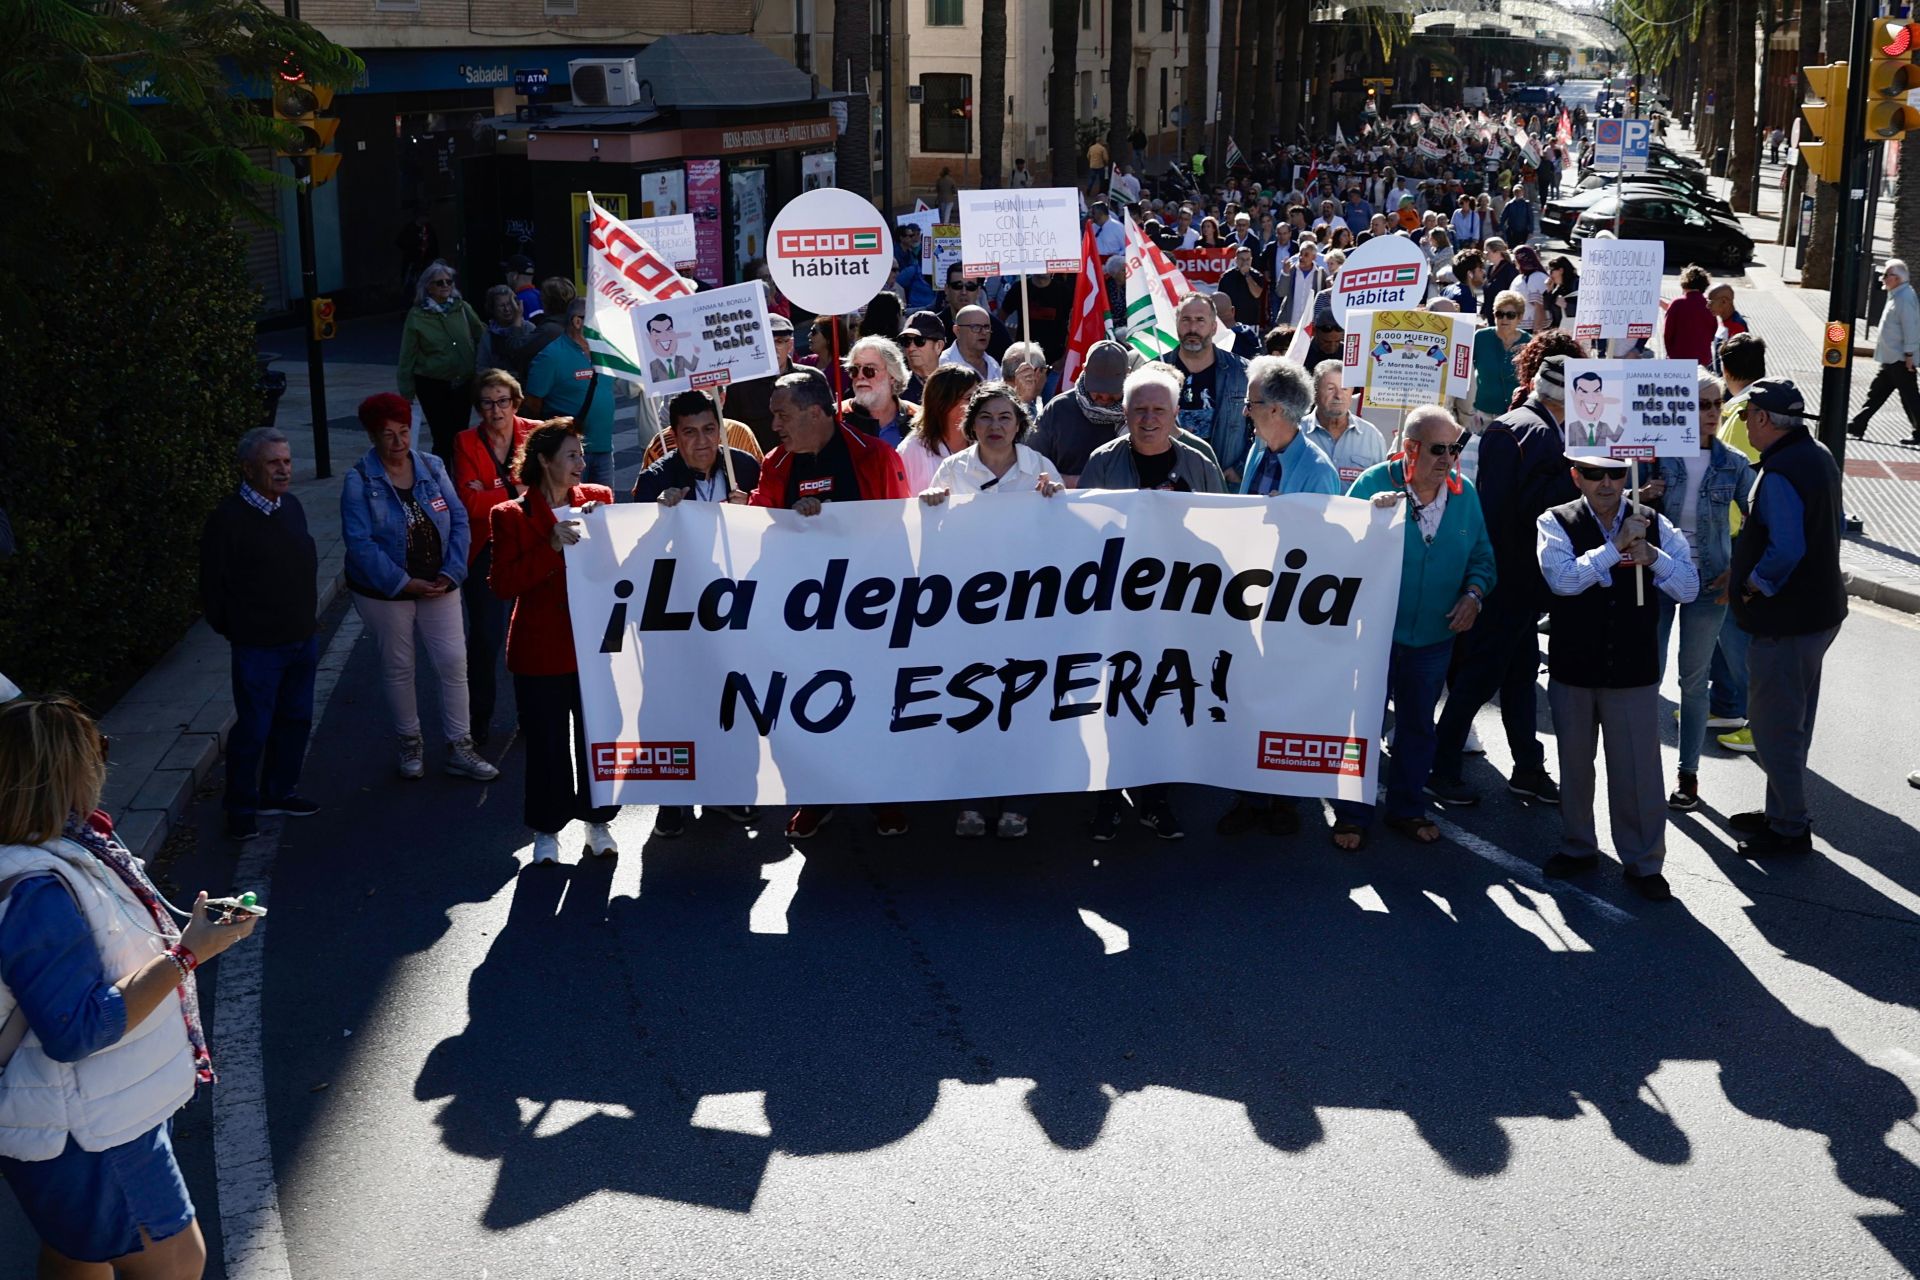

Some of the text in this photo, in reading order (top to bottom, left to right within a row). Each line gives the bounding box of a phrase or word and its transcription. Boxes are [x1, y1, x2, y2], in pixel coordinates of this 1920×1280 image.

[466, 65, 508, 83] Sabadell
[527, 74, 547, 83] ATM
[1625, 122, 1647, 149] P
[994, 199, 1045, 213] BONILLA
[996, 215, 1039, 230] CON LA
[783, 235, 849, 252] CCOO
[978, 231, 1057, 248] DEPENDENCIA
[1589, 249, 1656, 267] MORENO BONILLA
[793, 258, 870, 277] hábitat
[1342, 269, 1395, 288] CCOO
[727, 297, 752, 307] BONILLA
[1346, 288, 1406, 307] hábitat
[705, 309, 753, 327] Miente
[702, 319, 760, 341] más que
[713, 335, 754, 352] habla
[1376, 332, 1446, 346] 8.000 MUERTOS
[1346, 342, 1355, 365] CCOO
[1388, 361, 1414, 369] Moreno
[1415, 362, 1439, 372] Bonilla
[1456, 352, 1465, 376] CCOO
[693, 373, 721, 385] CCOO
[1663, 371, 1691, 379] BONILLA
[1637, 383, 1690, 398] Miente
[1632, 398, 1696, 415] más que
[1642, 411, 1687, 426] habla
[1612, 448, 1645, 456] CCOO
[800, 480, 824, 491] CCOO
[599, 537, 1363, 654] ¡La dependencia
[720, 648, 1234, 737] NO ESPERA!
[1264, 737, 1343, 759] CCOO
[598, 748, 671, 766] CCOO
[1264, 756, 1360, 773] Pensionistas Málaga
[598, 766, 689, 777] Pensionistas Málaga
